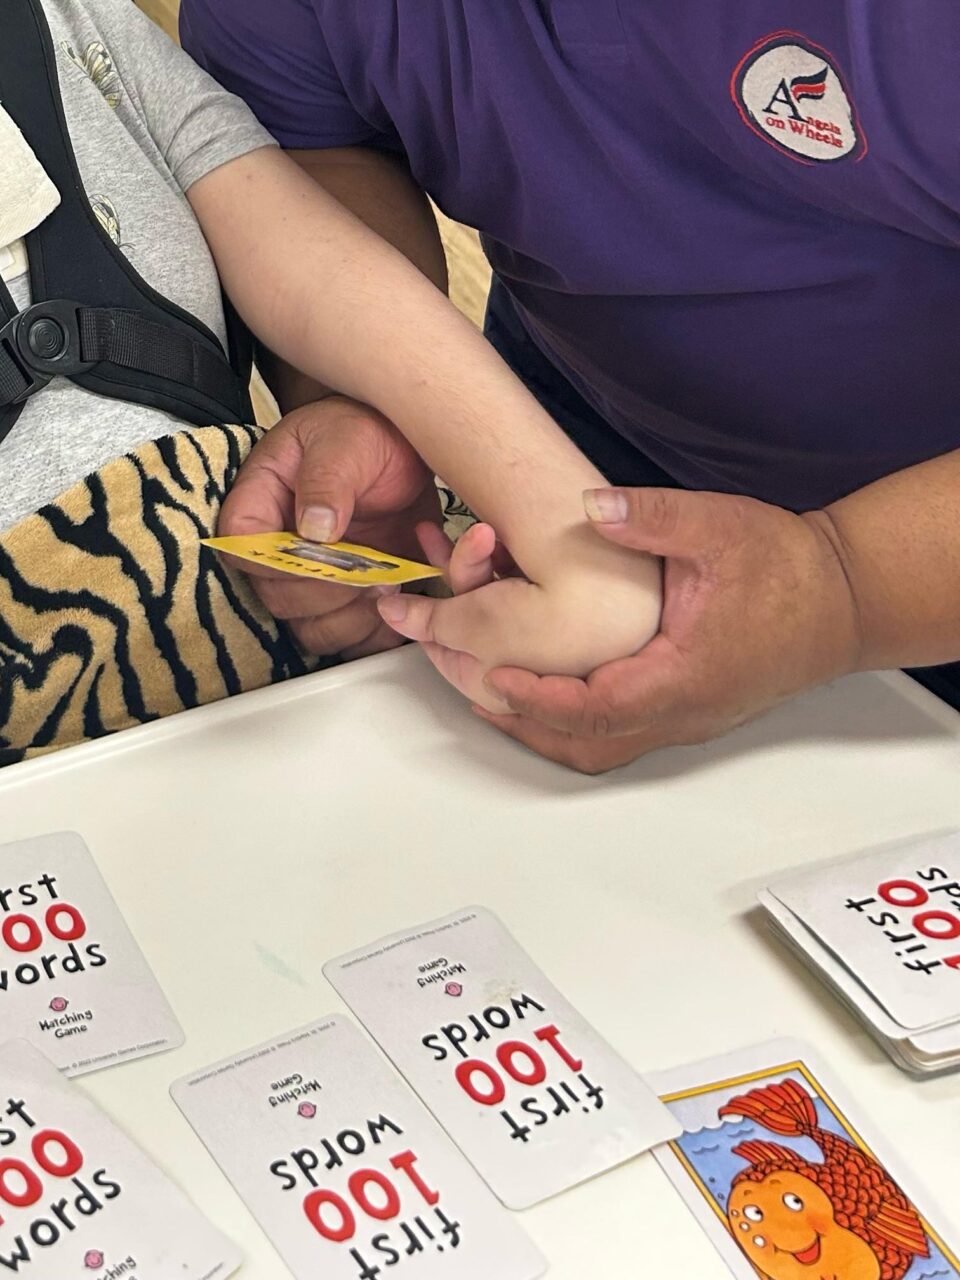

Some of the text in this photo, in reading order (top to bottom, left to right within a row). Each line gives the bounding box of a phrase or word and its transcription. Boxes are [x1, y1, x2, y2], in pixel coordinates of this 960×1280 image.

[765, 117, 844, 149] on Wheels
[844, 897, 942, 975] first
[877, 879, 960, 972] 00
[417, 963, 467, 989] Matching
[418, 957, 448, 974] Game
[39, 1009, 93, 1031] Matching
[55, 1024, 87, 1039] Game
[421, 993, 546, 1061] words
[270, 1073, 303, 1091] Game
[455, 1024, 583, 1106] 100
[268, 1079, 323, 1108] Matching
[500, 1073, 604, 1143] first
[269, 1113, 404, 1191] words
[302, 1149, 439, 1243] 100
[97, 1256, 137, 1280] ching
[349, 1207, 461, 1280] first
